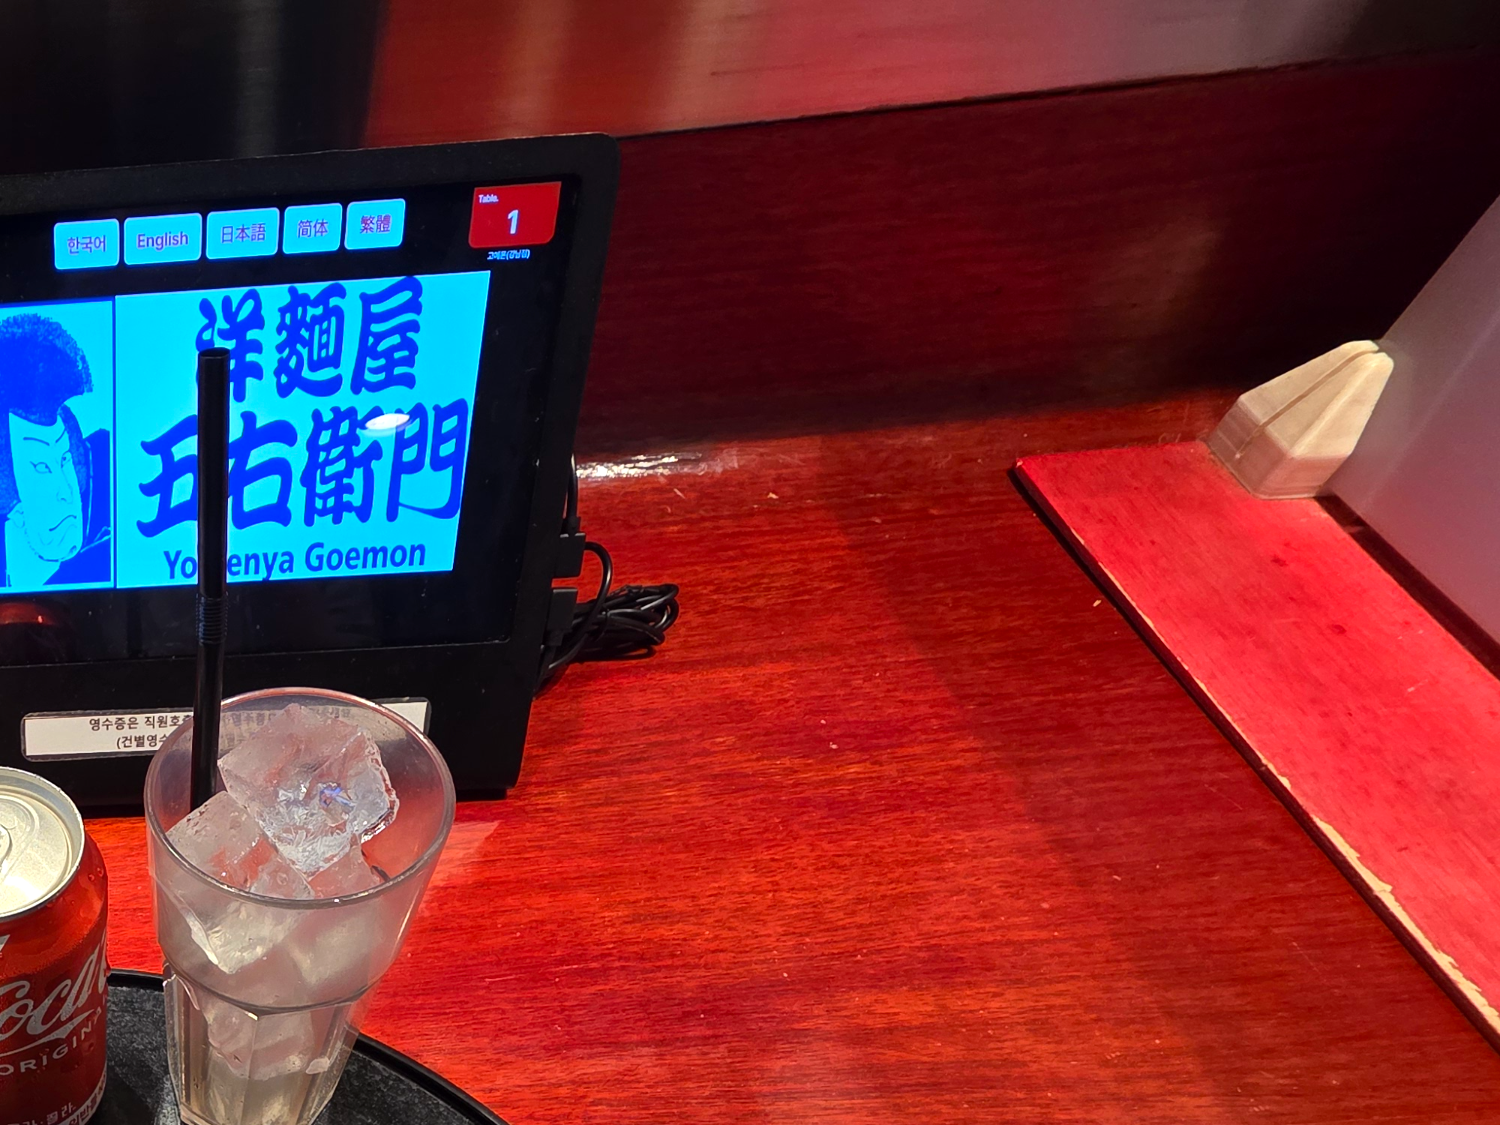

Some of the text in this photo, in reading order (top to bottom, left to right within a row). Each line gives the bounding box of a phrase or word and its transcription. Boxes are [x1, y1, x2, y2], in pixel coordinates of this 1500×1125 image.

[297, 218, 329, 238] 简体
[359, 214, 392, 234] 繁體
[507, 209, 519, 234] 1
[136, 231, 189, 252] English
[220, 223, 266, 244] 日本語
[67, 235, 106, 255] 한국어
[136, 397, 468, 538] 五右衛門
[164, 541, 426, 582] Yoenya Goemon
[89, 716, 139, 732] 영수증은
